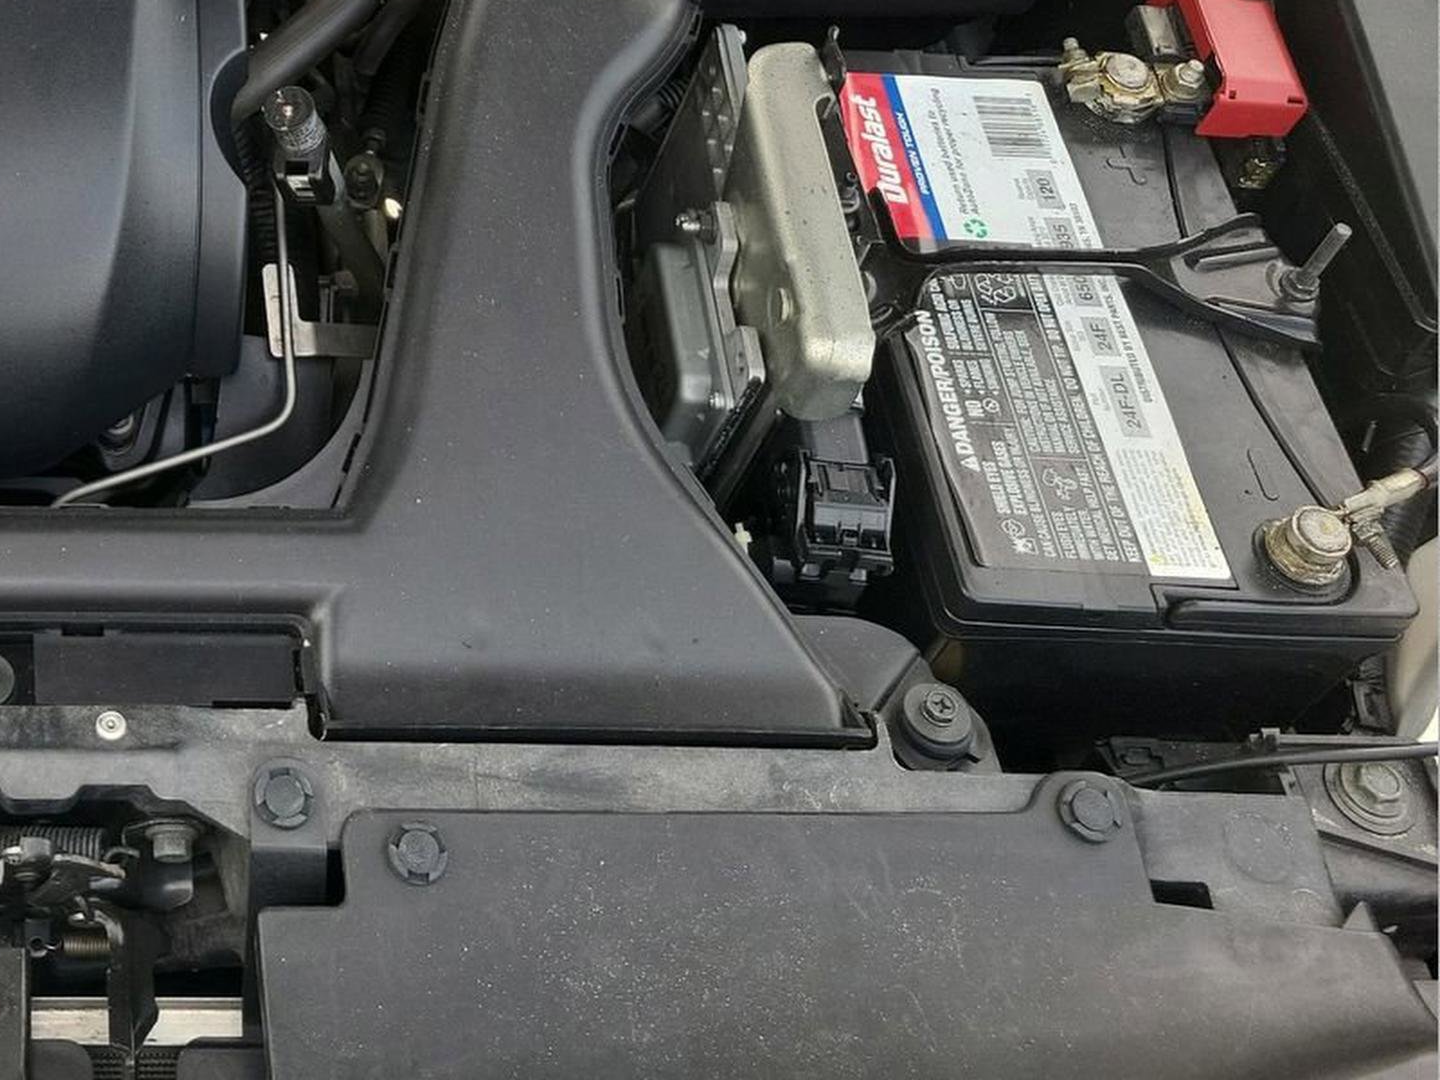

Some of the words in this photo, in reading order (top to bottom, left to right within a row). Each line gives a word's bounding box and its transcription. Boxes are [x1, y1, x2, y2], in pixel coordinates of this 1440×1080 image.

[925, 109, 936, 117] to
[927, 87, 951, 126] recycling
[894, 111, 914, 147] TOUGH
[927, 117, 949, 158] batteries
[942, 126, 962, 156] proper
[850, 94, 908, 204] Duralast
[906, 149, 931, 194] PROVEN
[941, 160, 958, 182] used
[949, 183, 968, 214] Return
[956, 172, 980, 215] AutoZone
[1033, 176, 1057, 201] 120
[945, 298, 962, 310] OR
[1031, 291, 1052, 312] OPEN
[949, 310, 975, 350] BLINDNESS
[982, 311, 1004, 342] FOLLOW
[1039, 311, 1057, 328] NOT
[1111, 320, 1128, 339] BEST
[1044, 328, 1061, 341] DO
[1088, 322, 1114, 351] 24F
[1119, 340, 1134, 351] BY
[950, 358, 973, 389] SPARKS
[964, 359, 987, 389] FLAMES
[1055, 358, 1074, 377] NOT
[1124, 351, 1154, 403] DISTRIBUTED
[913, 309, 975, 456] DANGER/POISON
[1061, 376, 1079, 390] DO
[963, 399, 986, 417] NO
[1106, 371, 1143, 429] 24F-DL
[1001, 426, 1024, 456] INJURY
[1058, 422, 1081, 454] SERVICE
[1083, 438, 1102, 452] OF
[989, 439, 1013, 468] GASES
[1011, 455, 1028, 469] OR
[1088, 452, 1113, 483] REACH
[981, 460, 1001, 483] EYES
[988, 483, 1011, 514] SHIELD
[999, 468, 1028, 515] EXPLOSIVE
[1015, 468, 1043, 512] BLINDNESS
[1081, 487, 1101, 509] HELP
[1099, 482, 1121, 503] THE
[1049, 510, 1069, 532] EYES
[1107, 504, 1126, 518] OF
[1029, 512, 1052, 540] CAUSE
[1112, 518, 1134, 539] OUT
[1038, 540, 1057, 557] CAN
[1056, 531, 1079, 559] FLUSH
[1101, 544, 1120, 561] GET
[1119, 538, 1143, 563] KEEP
